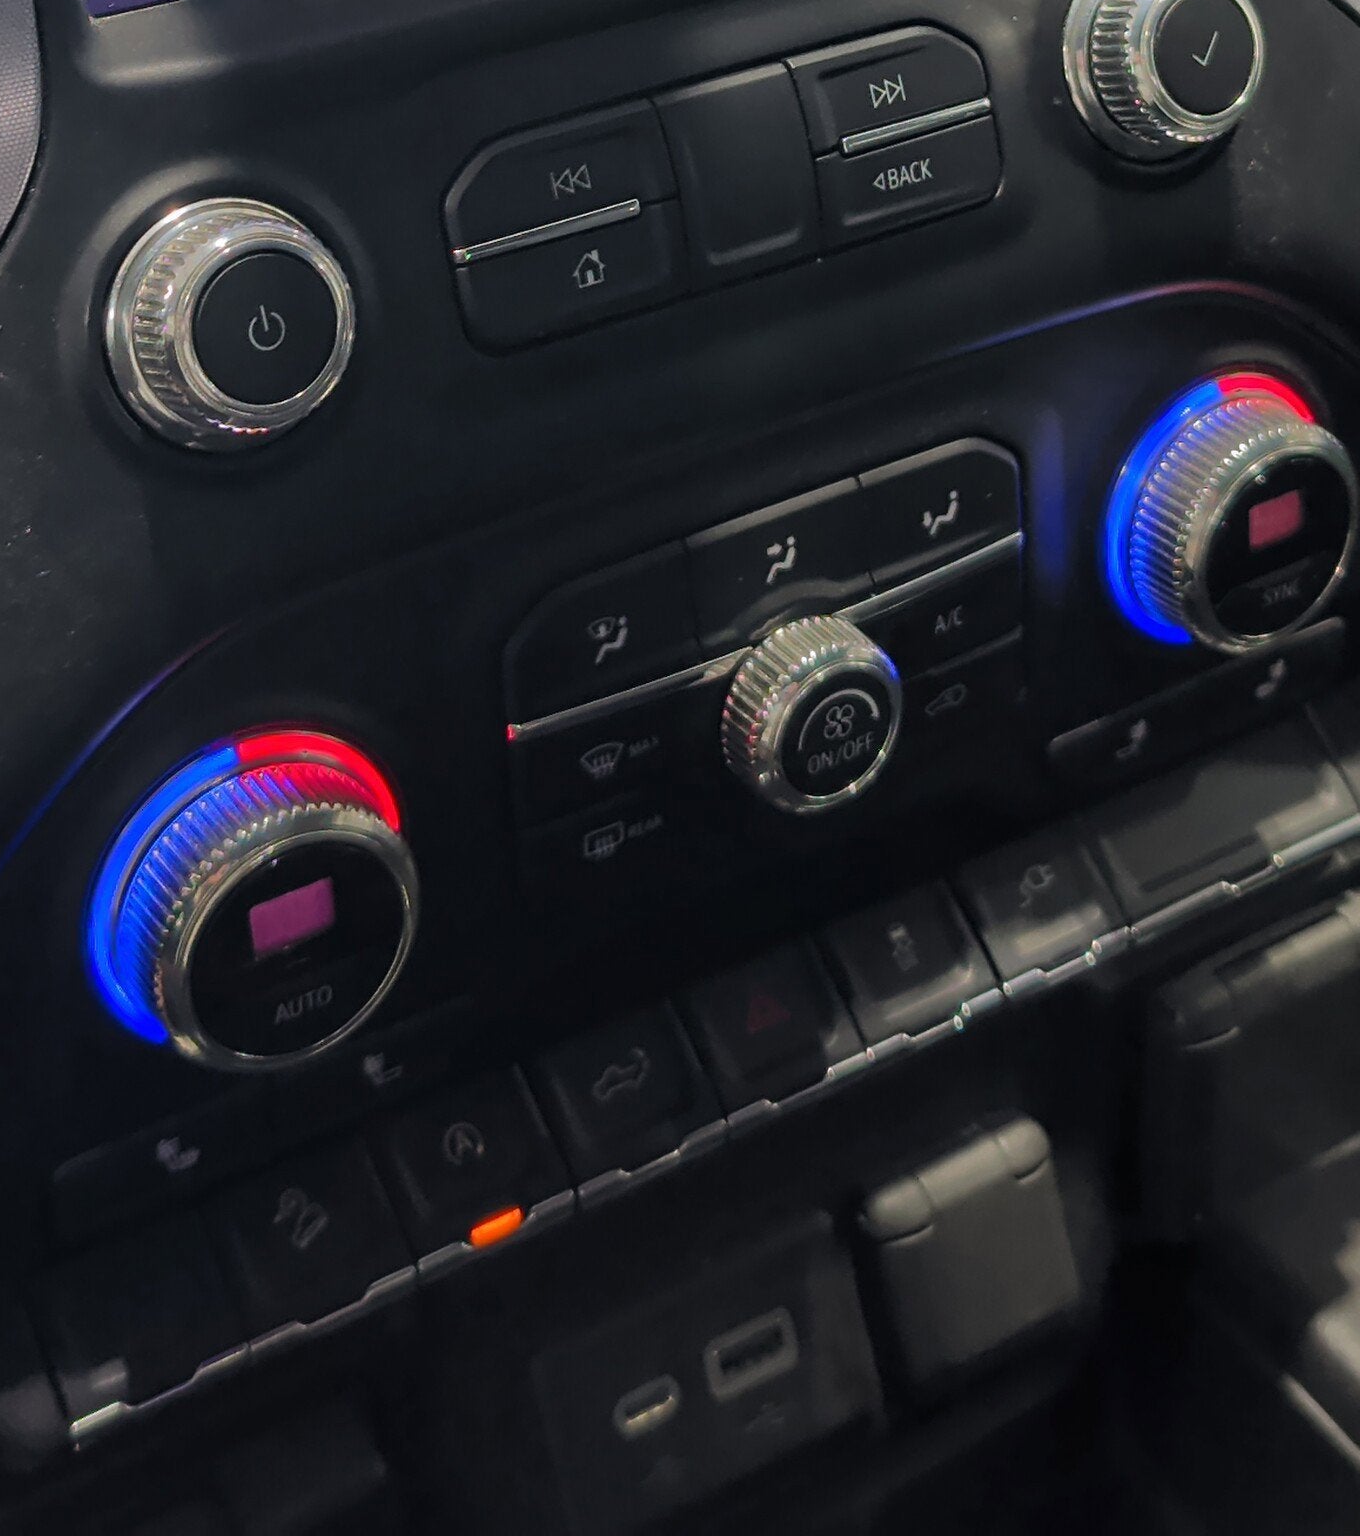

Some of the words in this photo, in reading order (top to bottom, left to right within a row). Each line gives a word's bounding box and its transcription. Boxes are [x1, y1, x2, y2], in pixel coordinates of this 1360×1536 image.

[886, 158, 933, 190] BACK
[934, 604, 964, 635] A/C
[807, 731, 875, 774] ON/OFF
[274, 984, 334, 1025] AUTO
